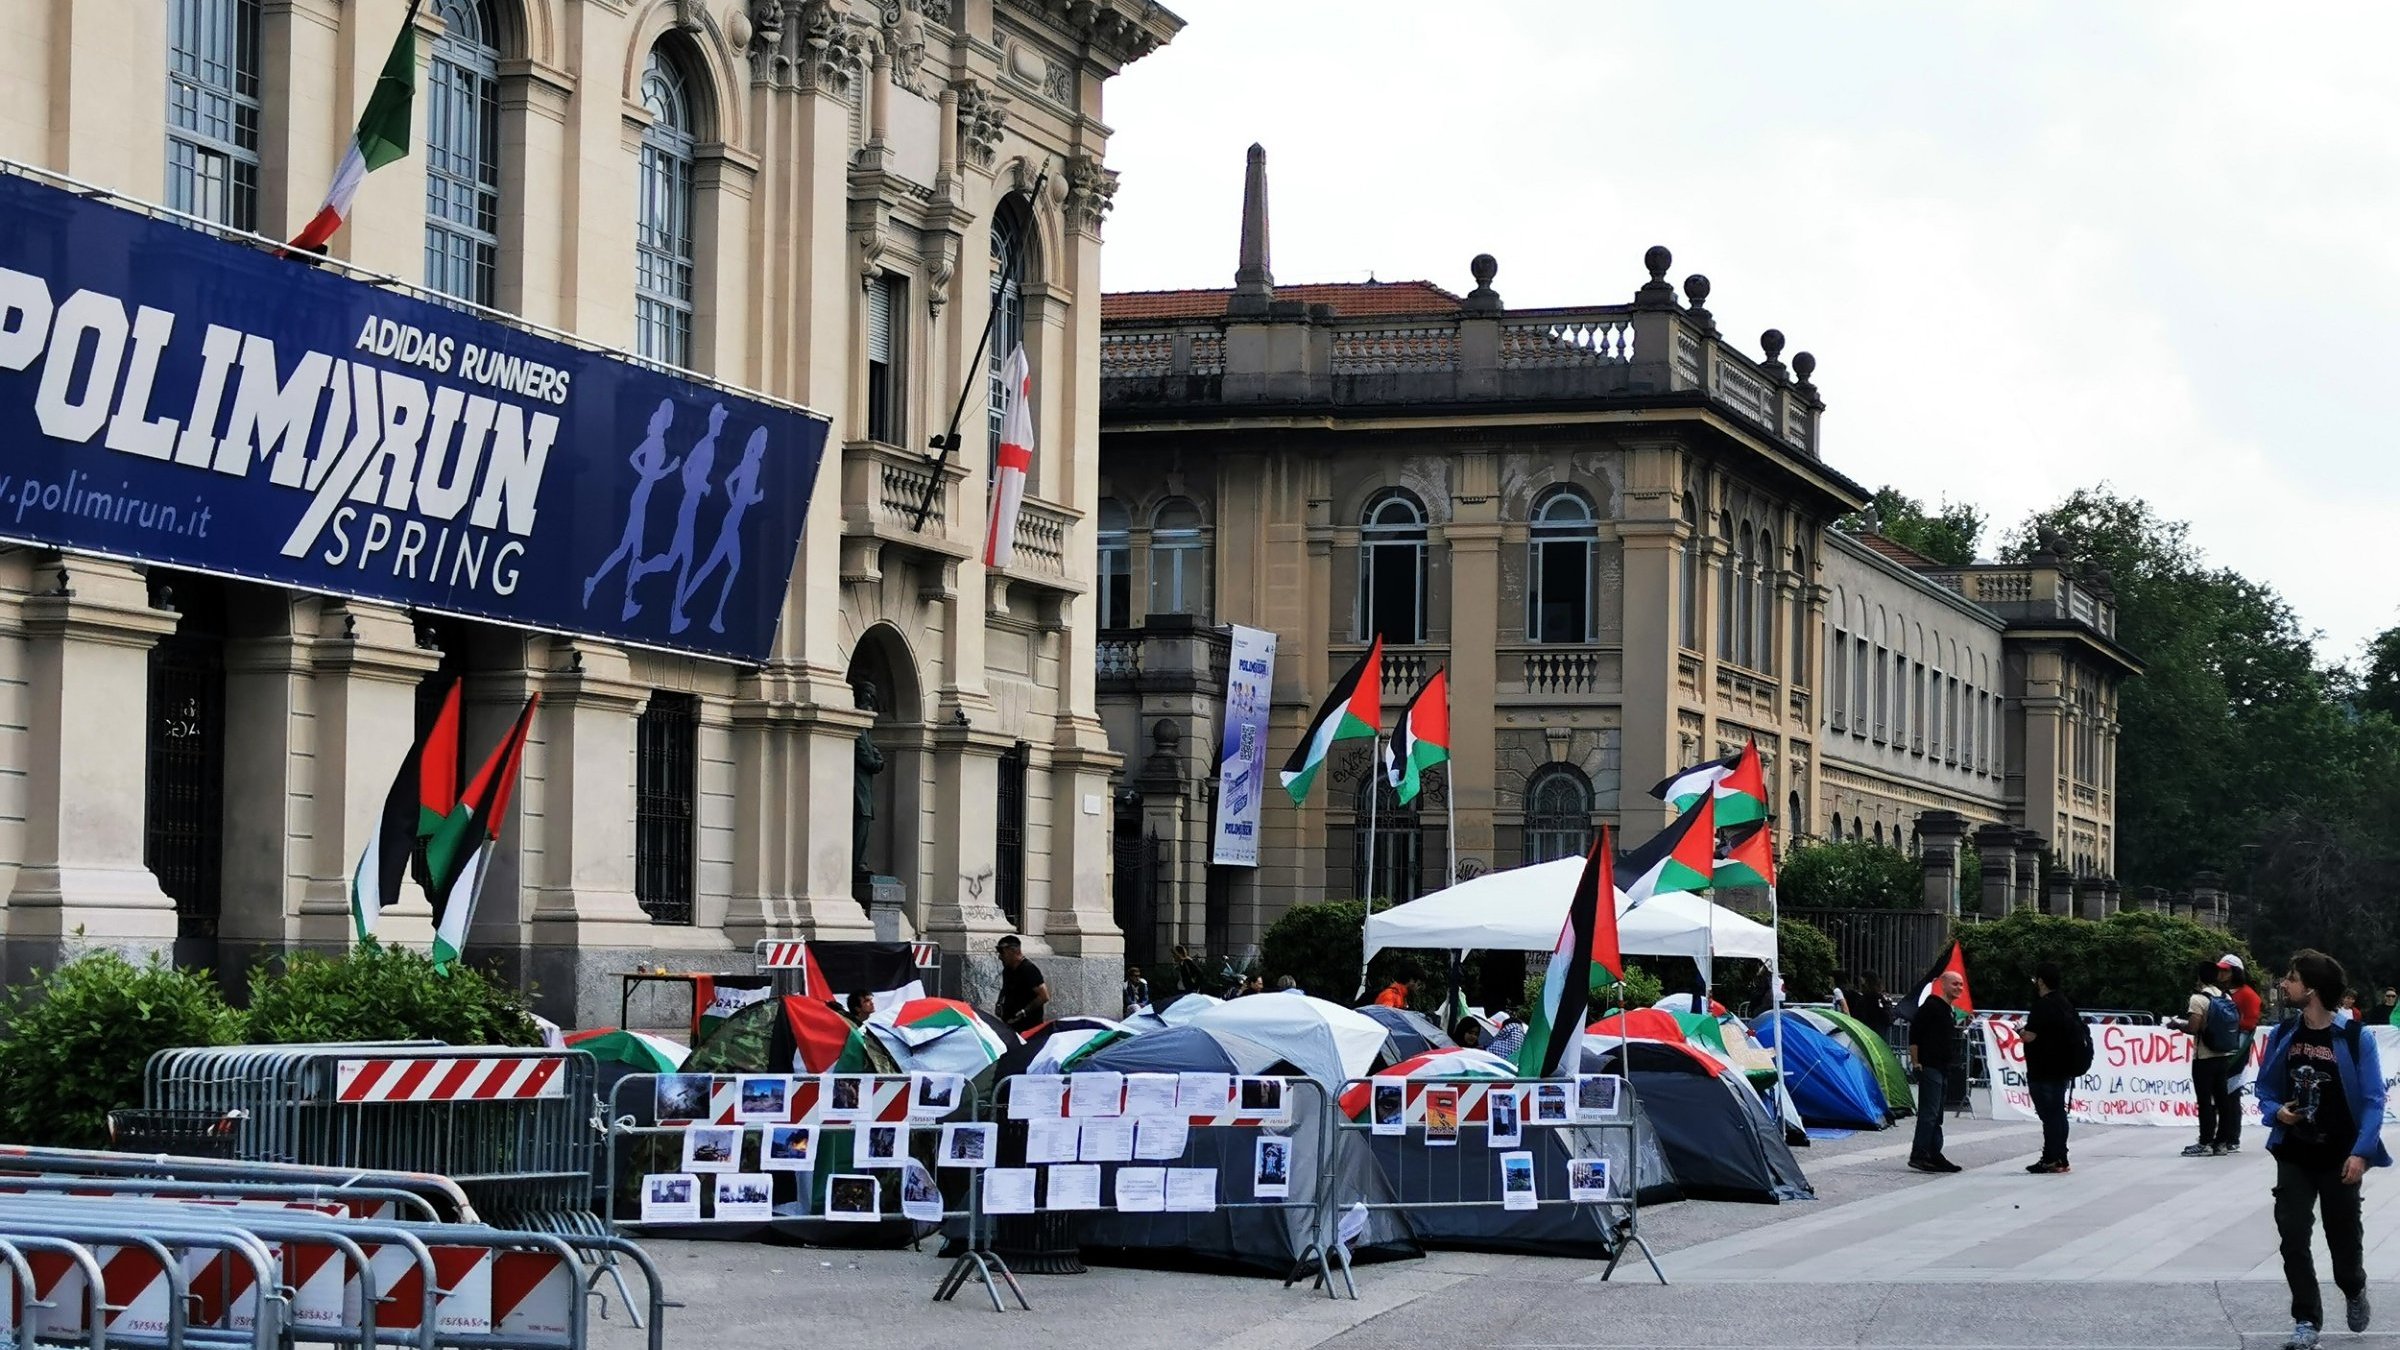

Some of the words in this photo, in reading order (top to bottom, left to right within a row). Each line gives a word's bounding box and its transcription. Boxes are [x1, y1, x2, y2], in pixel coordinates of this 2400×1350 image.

[355, 315, 454, 373] ADIDAS
[459, 344, 570, 405] RUNNERS
[324, 506, 525, 596] SPRING
[2098, 1099, 2155, 1114] COMPLICITY
[2110, 1076, 2123, 1093] LA
